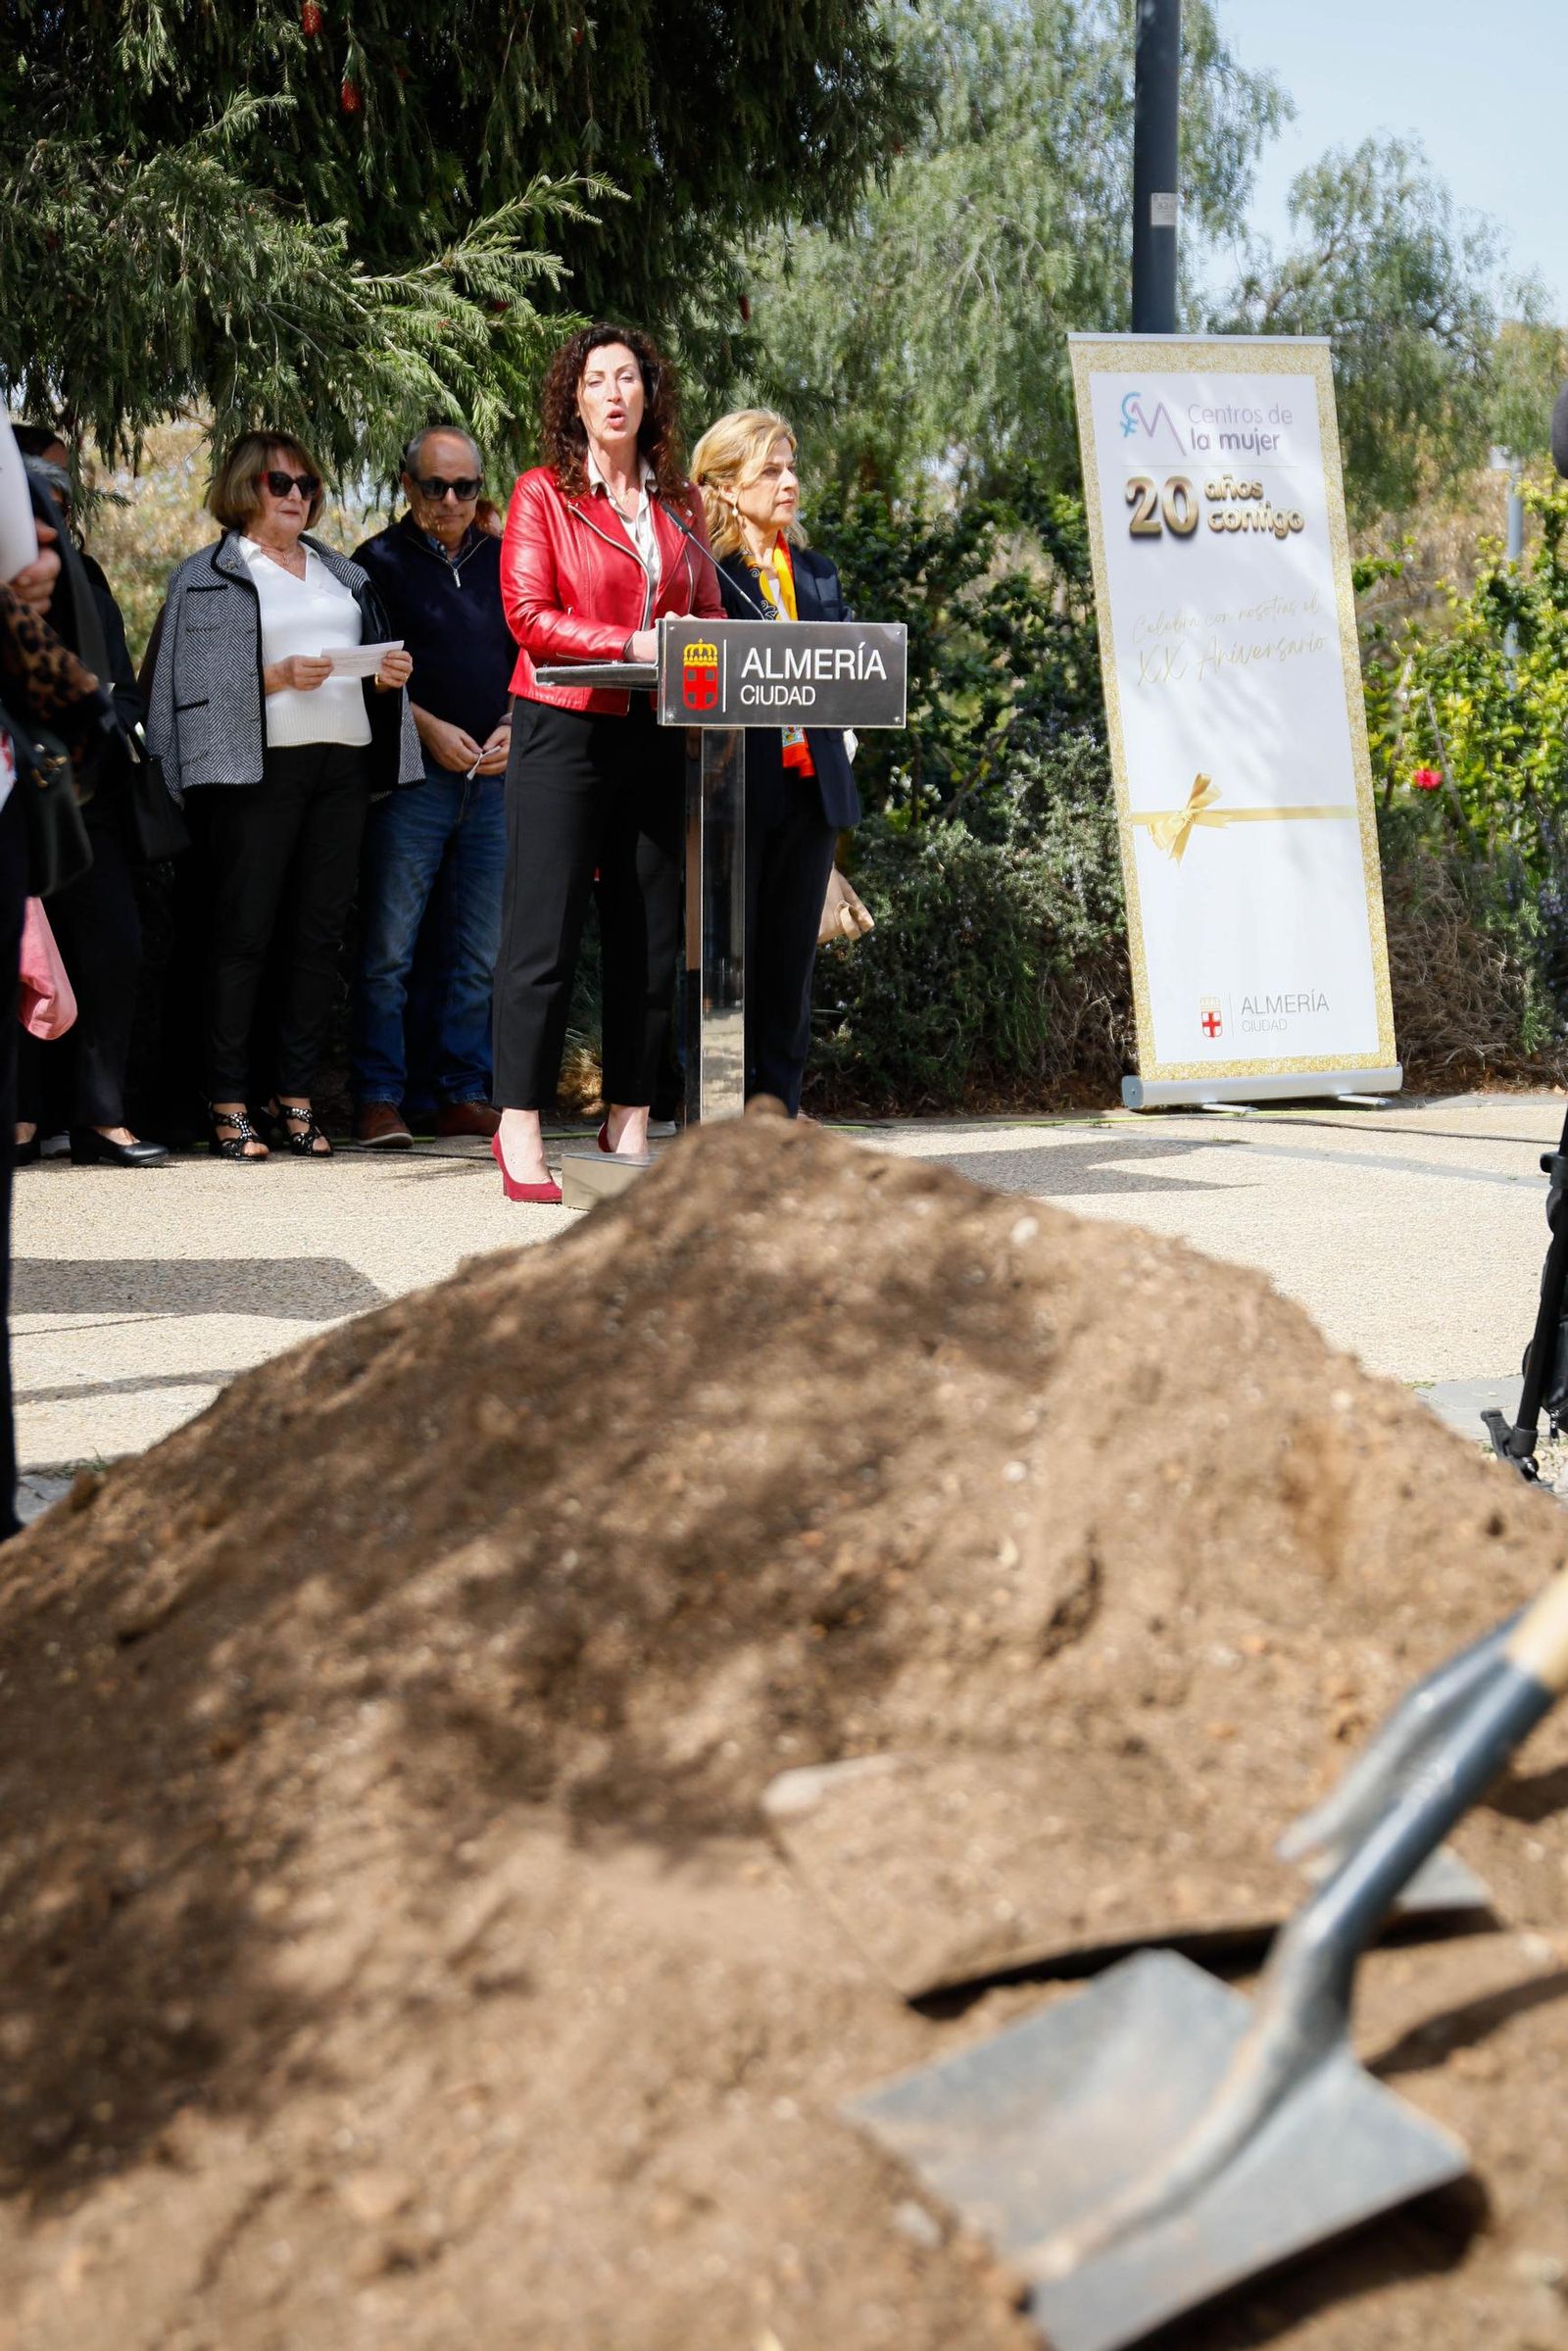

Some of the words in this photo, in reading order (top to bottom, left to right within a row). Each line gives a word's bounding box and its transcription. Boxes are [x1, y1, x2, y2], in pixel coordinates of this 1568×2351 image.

[1188, 404, 1263, 424] Centros
[1268, 403, 1294, 424] de
[1191, 427, 1211, 450] la
[1219, 428, 1281, 456] mujer
[1204, 474, 1264, 501] años
[1125, 475, 1200, 538] 20
[1208, 501, 1304, 539] contigo
[741, 642, 887, 680] ALMERÍA
[1137, 640, 1190, 686] XX
[1198, 632, 1325, 681] Aniversario
[740, 684, 816, 706] CIUDAD
[1241, 989, 1330, 1015] ALMERÍA
[1241, 1017, 1288, 1032] CIUDAD
